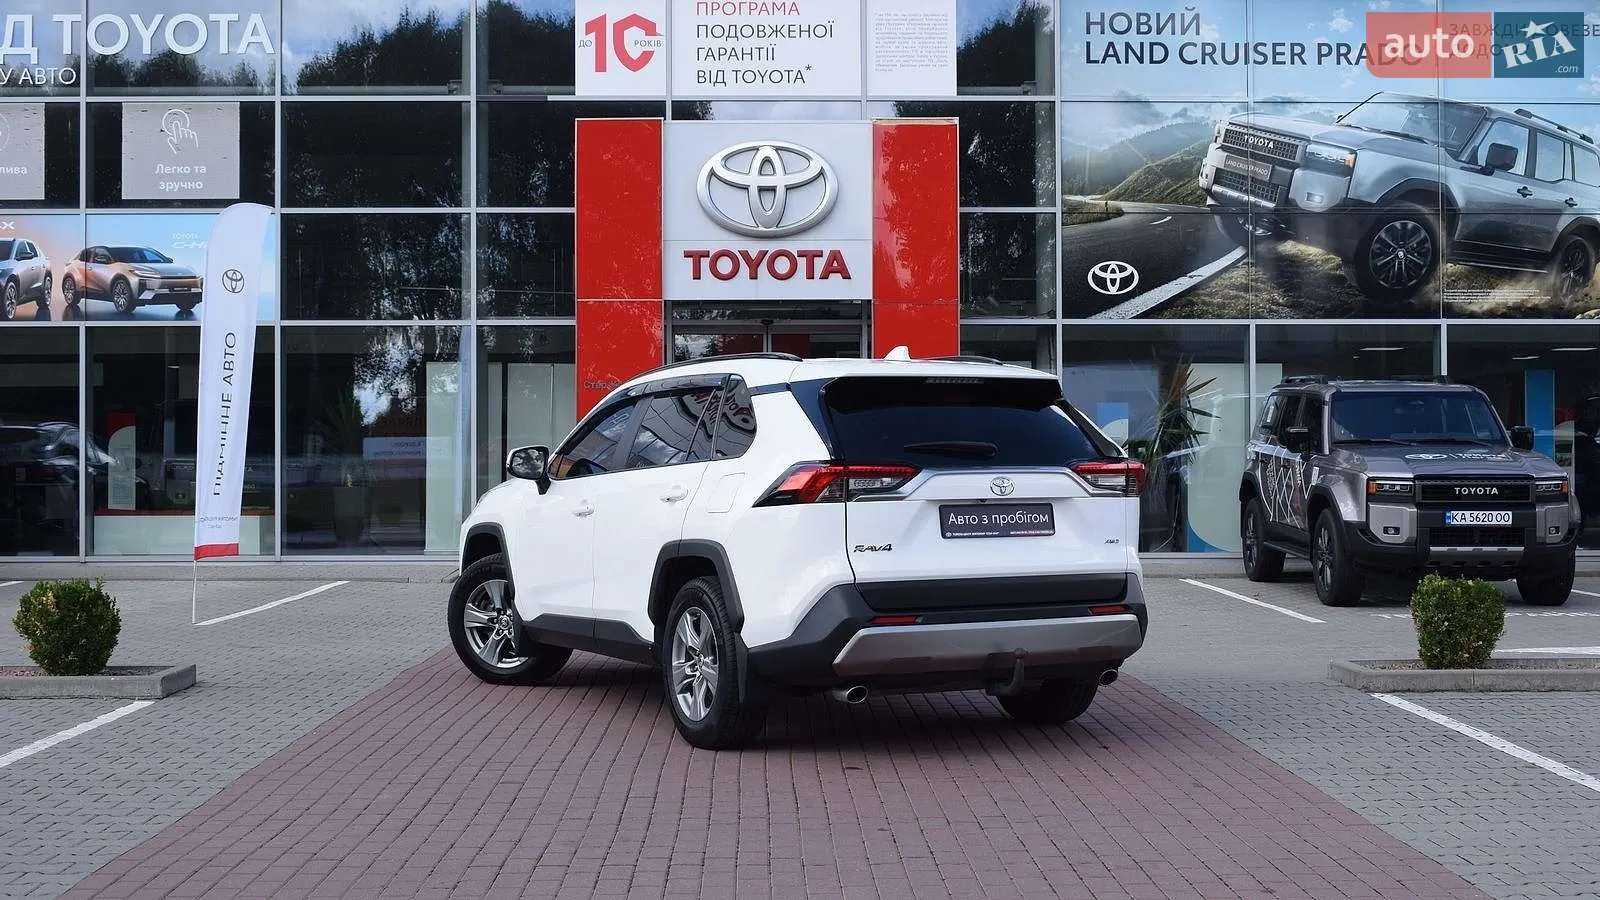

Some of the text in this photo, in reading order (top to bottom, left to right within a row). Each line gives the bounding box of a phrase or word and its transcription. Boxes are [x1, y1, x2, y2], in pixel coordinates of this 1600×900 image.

[696, 1, 801, 16] ПРОГРАМА
[1085, 6, 1201, 36] НОВИЙ
[0, 13, 275, 64] Д TOYOTA
[695, 20, 834, 41] ПОДОВЖЕНОЇ
[578, 39, 592, 48] ДО
[633, 39, 662, 48] РОКІВ
[696, 44, 776, 62] ГАРАНТІЇ
[1085, 42, 1424, 66] LAND CRUISER PRADO
[18, 67, 77, 85] АВТО
[696, 69, 727, 87] ВІД
[1244, 135, 1274, 149] TOYOTA
[154, 164, 207, 174] Легко та
[159, 180, 203, 192] зручно
[683, 248, 853, 282] TOYOTA
[221, 331, 237, 386] АВТО
[1454, 487, 1499, 495] TOYOTA
[948, 510, 1049, 526] Авто з пробігом
[1451, 512, 1467, 523] KA
[1469, 512, 1494, 523] 5620
[853, 543, 893, 553] RAV4
